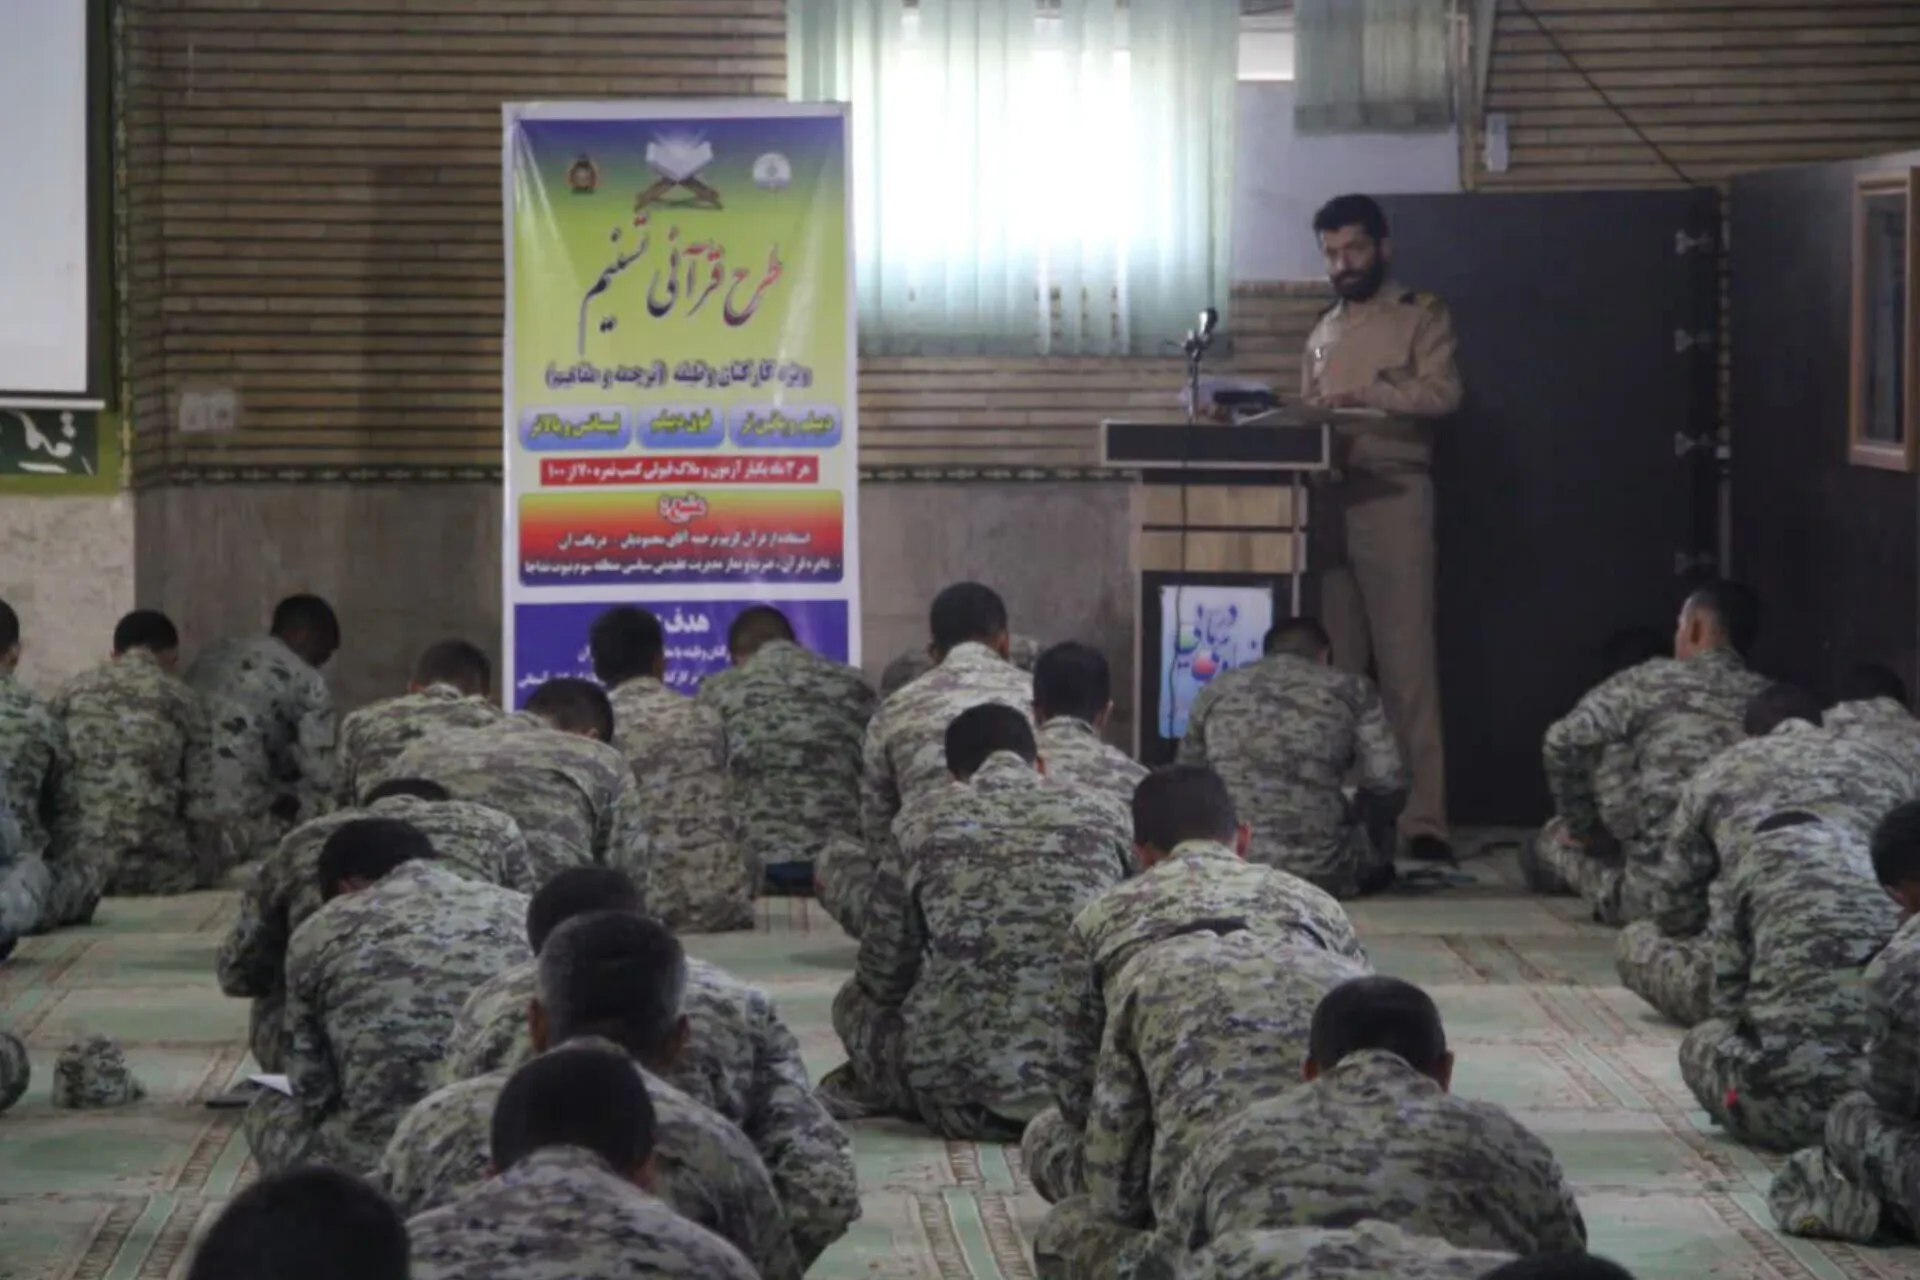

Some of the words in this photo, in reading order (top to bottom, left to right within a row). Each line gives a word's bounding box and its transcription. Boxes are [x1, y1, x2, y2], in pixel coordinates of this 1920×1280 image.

[577, 211, 651, 356] تسنیم
[646, 224, 726, 319] قرآنی
[723, 241, 783, 328] طرح
[673, 359, 717, 388] وظیفه
[717, 358, 776, 389] کارکنان
